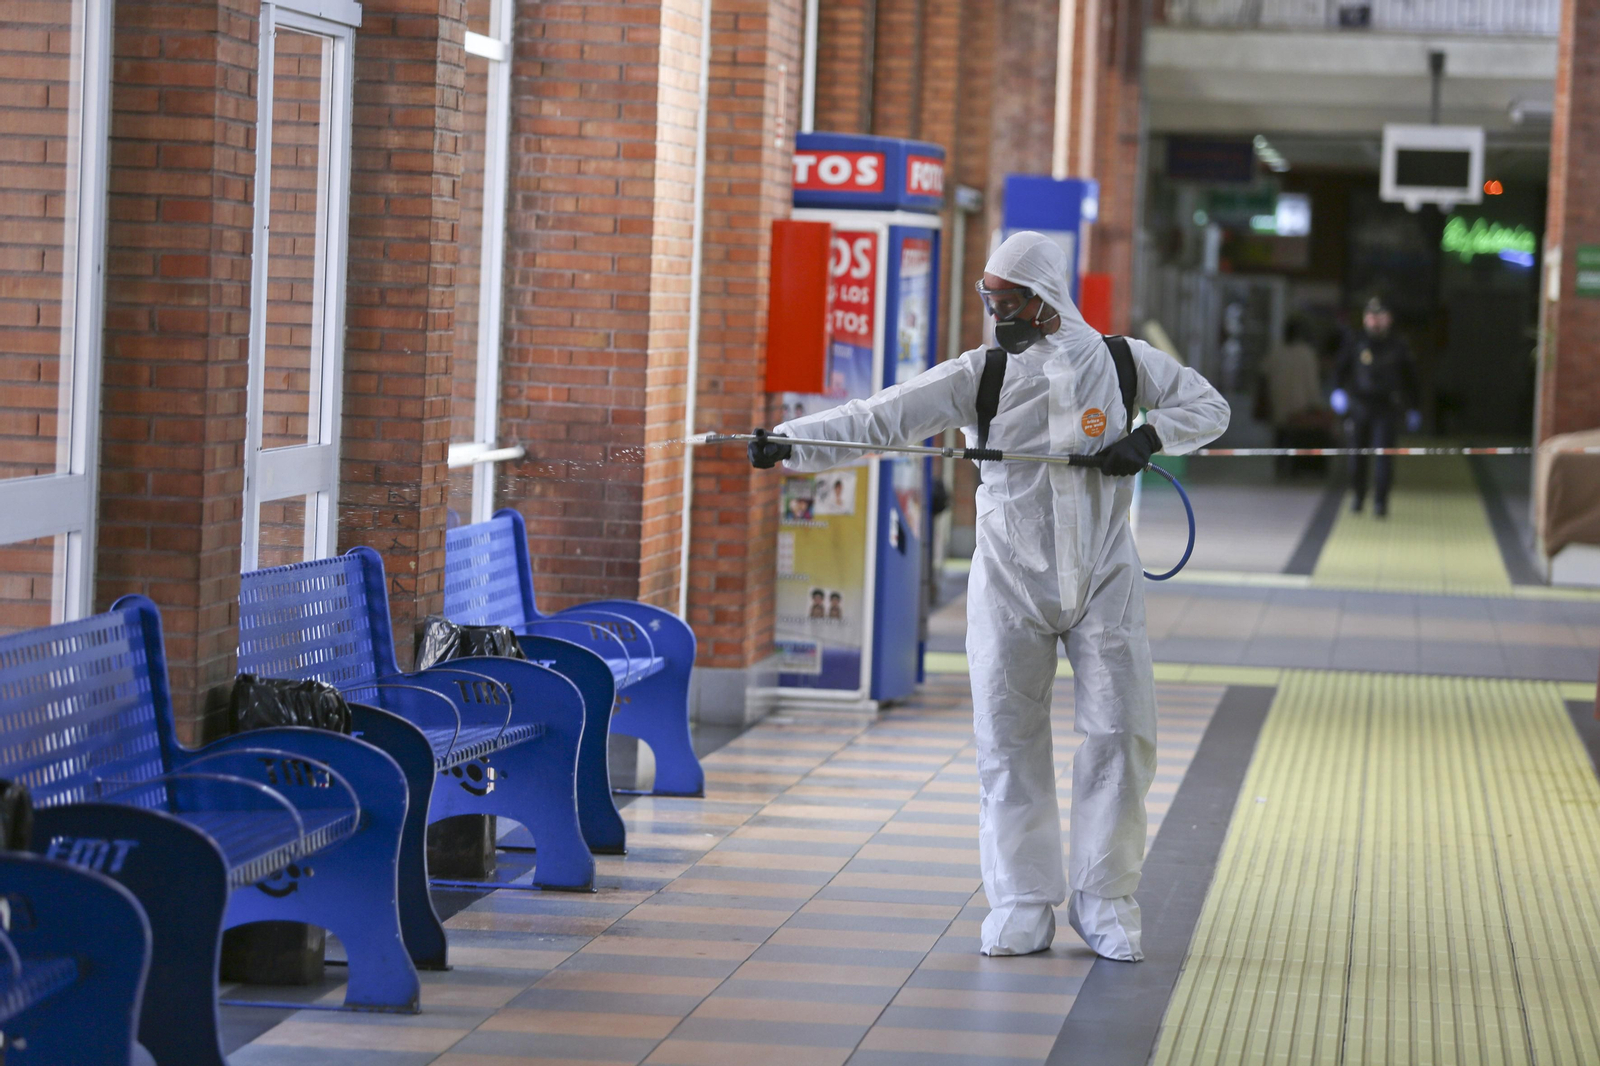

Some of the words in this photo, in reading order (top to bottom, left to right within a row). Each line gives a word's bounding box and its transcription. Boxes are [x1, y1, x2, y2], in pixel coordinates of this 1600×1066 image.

[793, 155, 878, 185] TOS
[840, 285, 869, 304] LOS
[46, 836, 140, 873] EMT
